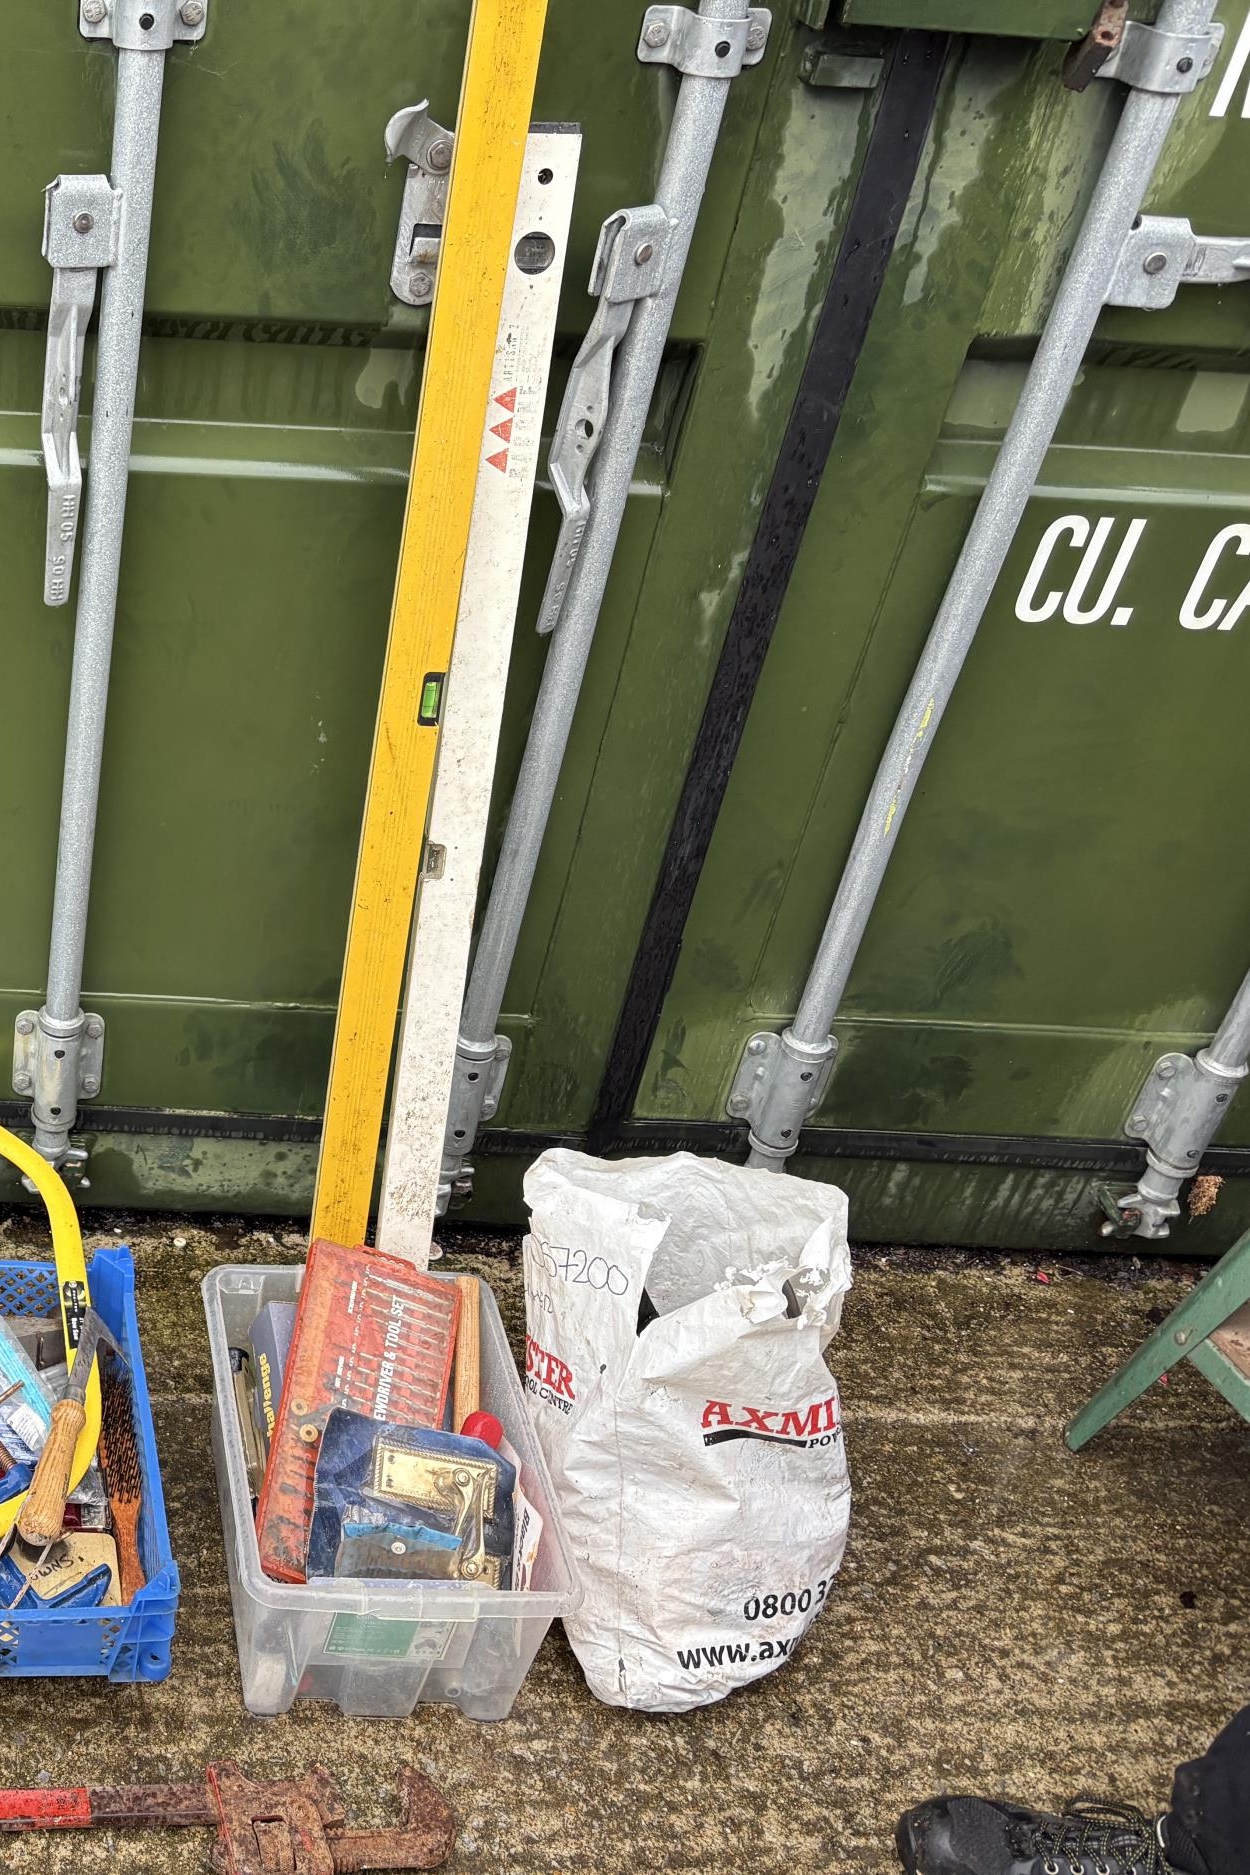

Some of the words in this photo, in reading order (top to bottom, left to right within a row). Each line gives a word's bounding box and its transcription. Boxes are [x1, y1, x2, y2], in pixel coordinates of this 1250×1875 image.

[1015, 515, 1147, 625] CU.
[391, 1295, 404, 1317] SET
[384, 1319, 401, 1349] TOOL
[384, 1350, 396, 1361] &
[526, 1334, 576, 1400] STER
[259, 1352, 276, 1440] hallenge
[374, 1360, 393, 1422] EWDRIVER
[701, 1397, 839, 1436] AXMI
[744, 1589, 812, 1621] 0800
[677, 1636, 799, 1670] www.ax
